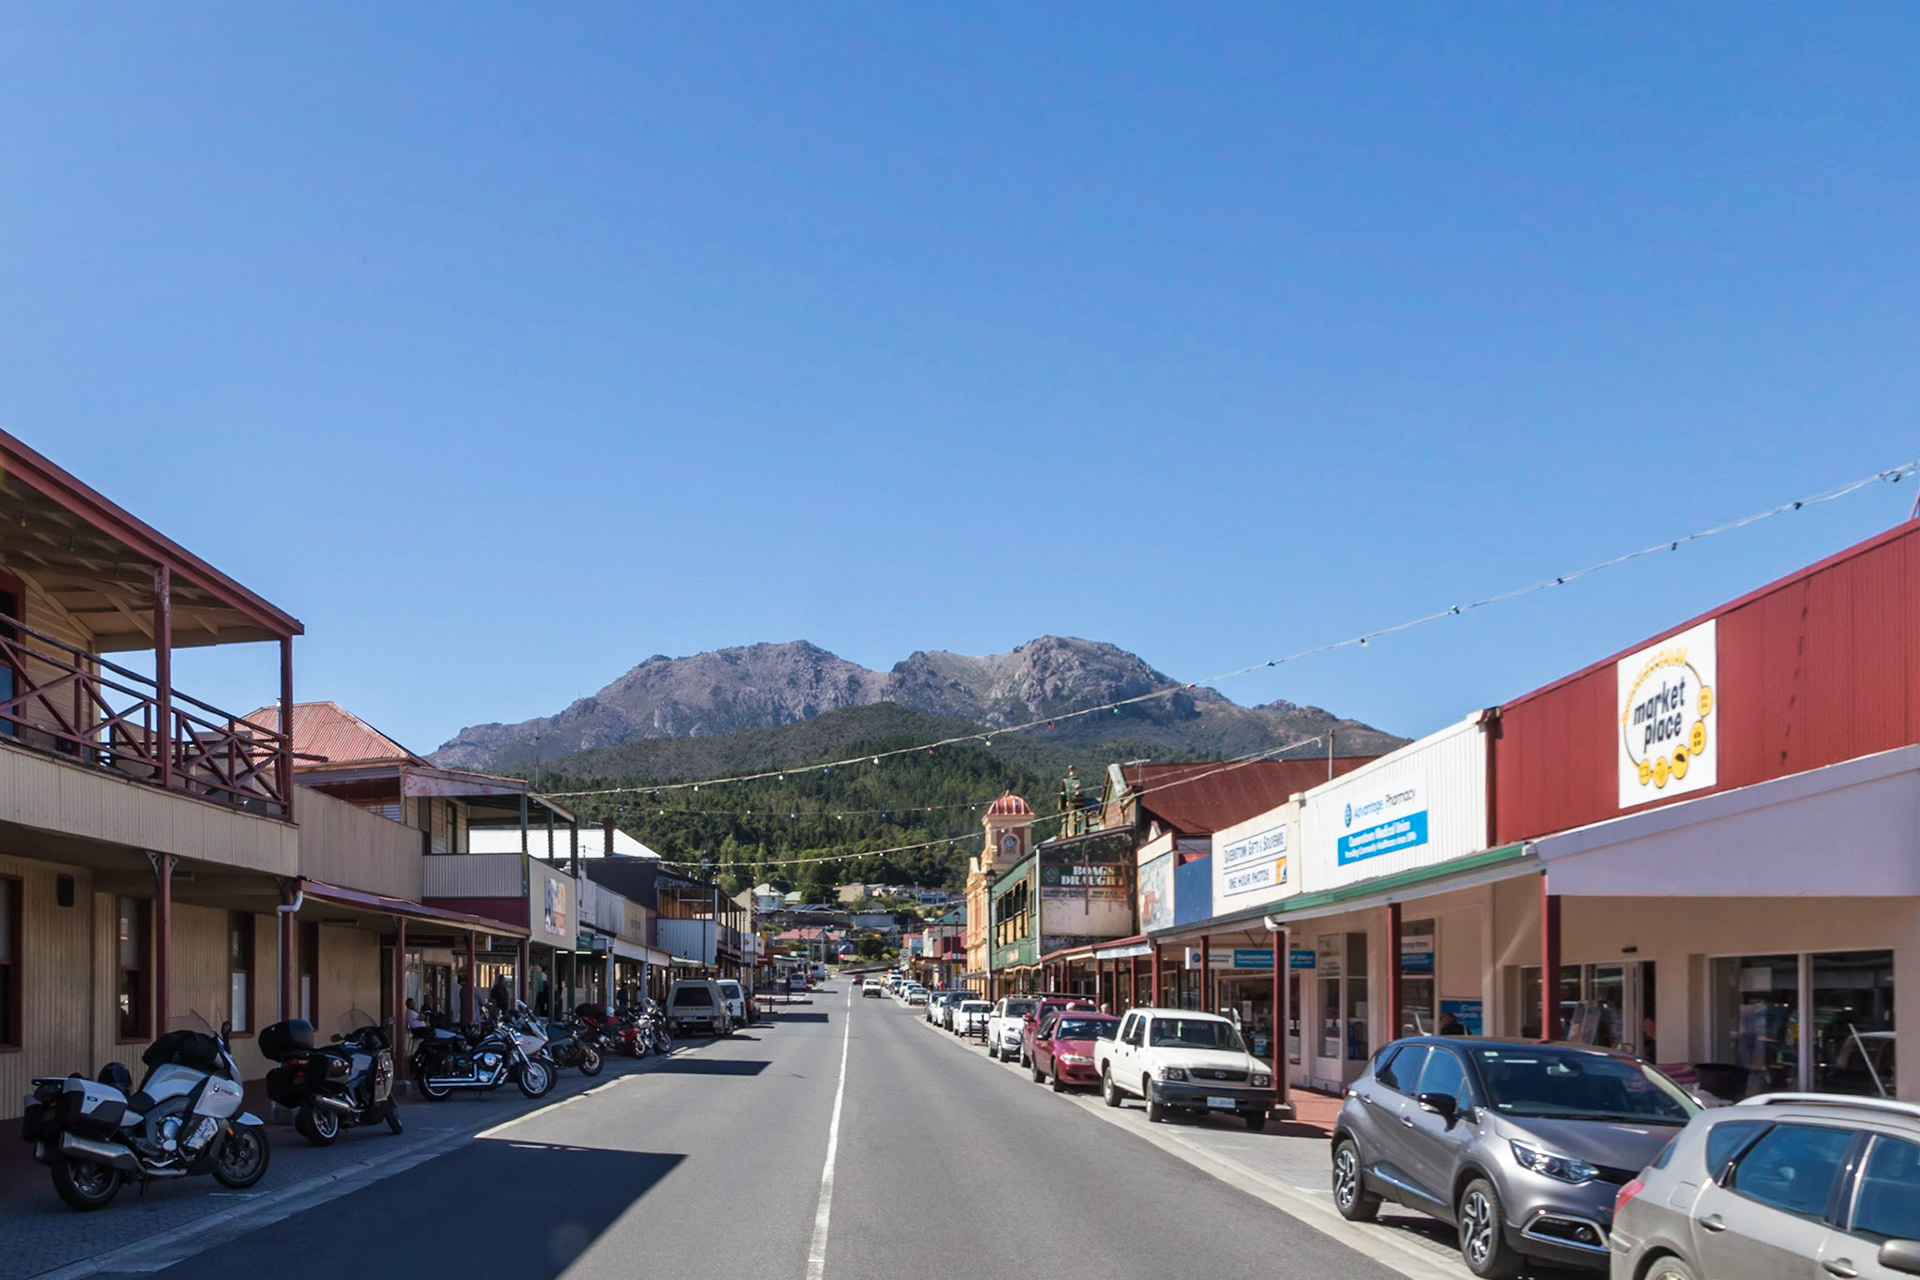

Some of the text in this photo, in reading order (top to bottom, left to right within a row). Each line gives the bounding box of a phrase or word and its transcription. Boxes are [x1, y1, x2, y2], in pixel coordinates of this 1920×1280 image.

[1633, 676, 1686, 726] market
[1643, 711, 1682, 754] place
[1353, 787, 1416, 818] Advantage Pharmacy
